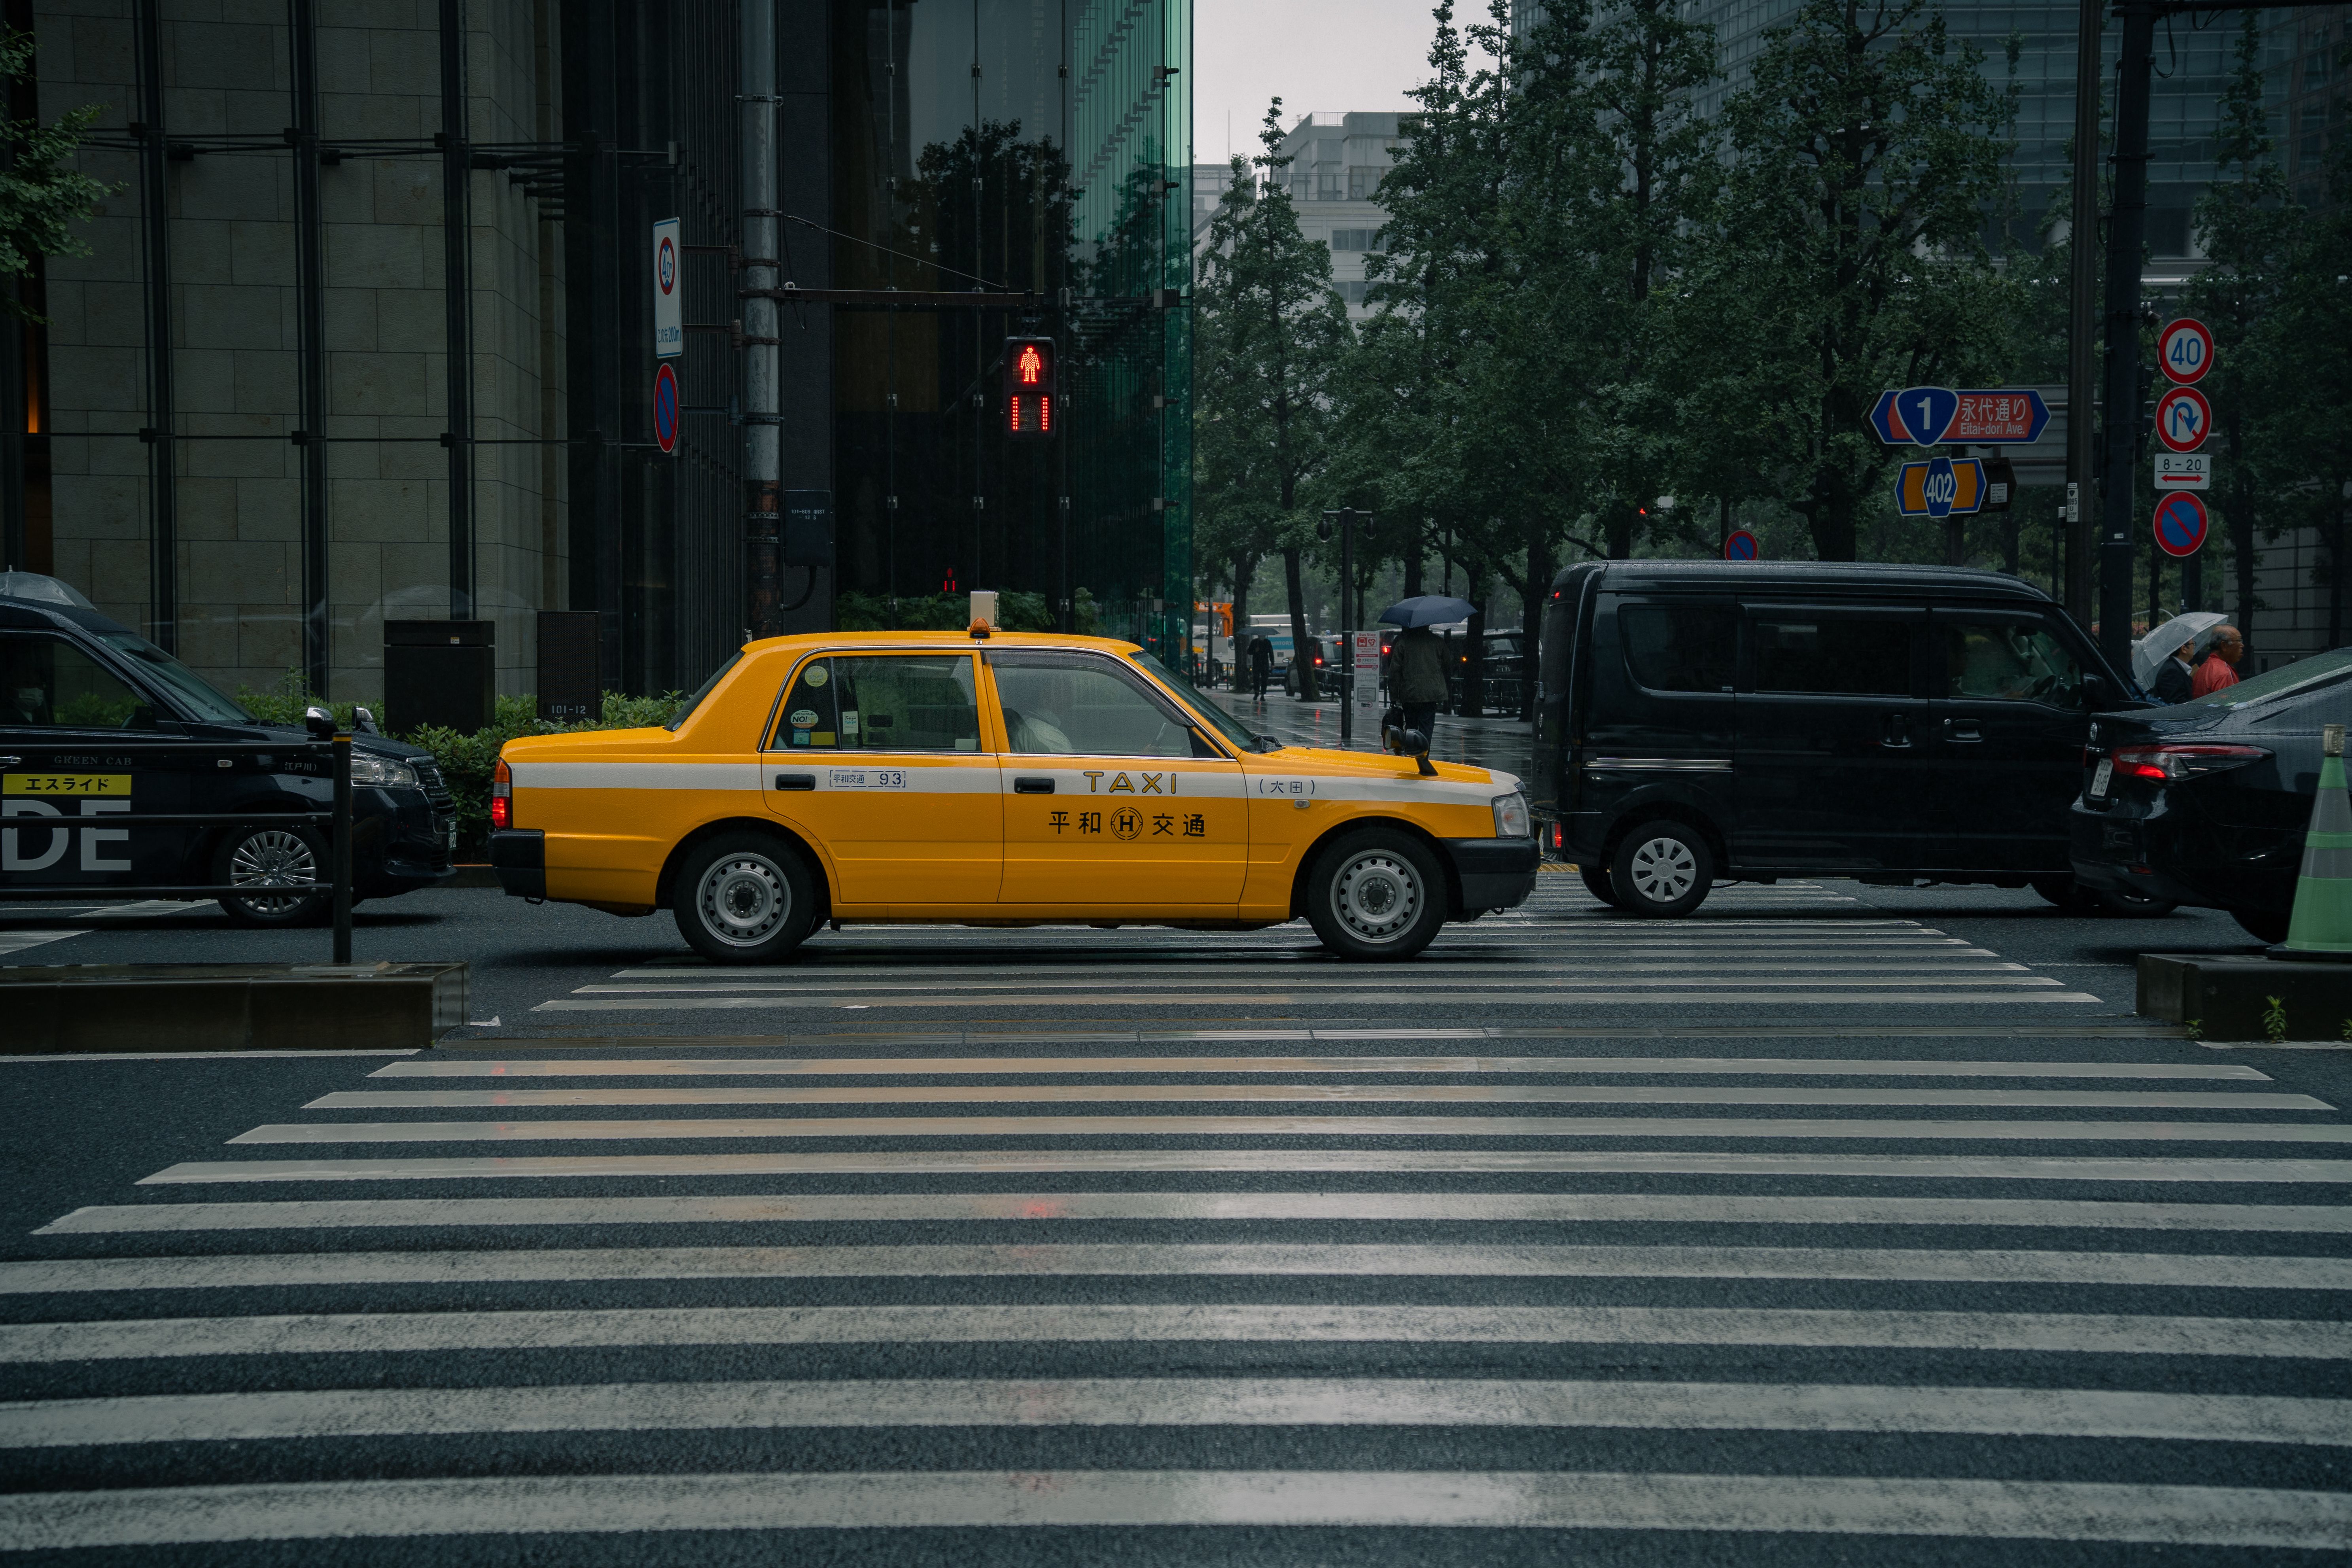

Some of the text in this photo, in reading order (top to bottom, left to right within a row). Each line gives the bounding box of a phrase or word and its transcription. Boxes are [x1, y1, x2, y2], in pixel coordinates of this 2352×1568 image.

[2171, 338, 2201, 365] 40
[1917, 397, 1931, 429] 1
[1962, 398, 2025, 421] 永代通り
[1961, 422, 2025, 435] Eitai-dori Ave.
[1926, 473, 1953, 503] 402
[552, 705, 586, 714] 101-12
[54, 756, 132, 765] GREEN CAB
[25, 778, 109, 791] エスライド
[834, 774, 864, 783] 平和交通
[1083, 772, 1177, 794] TAXI
[1260, 779, 1315, 795] (大田)
